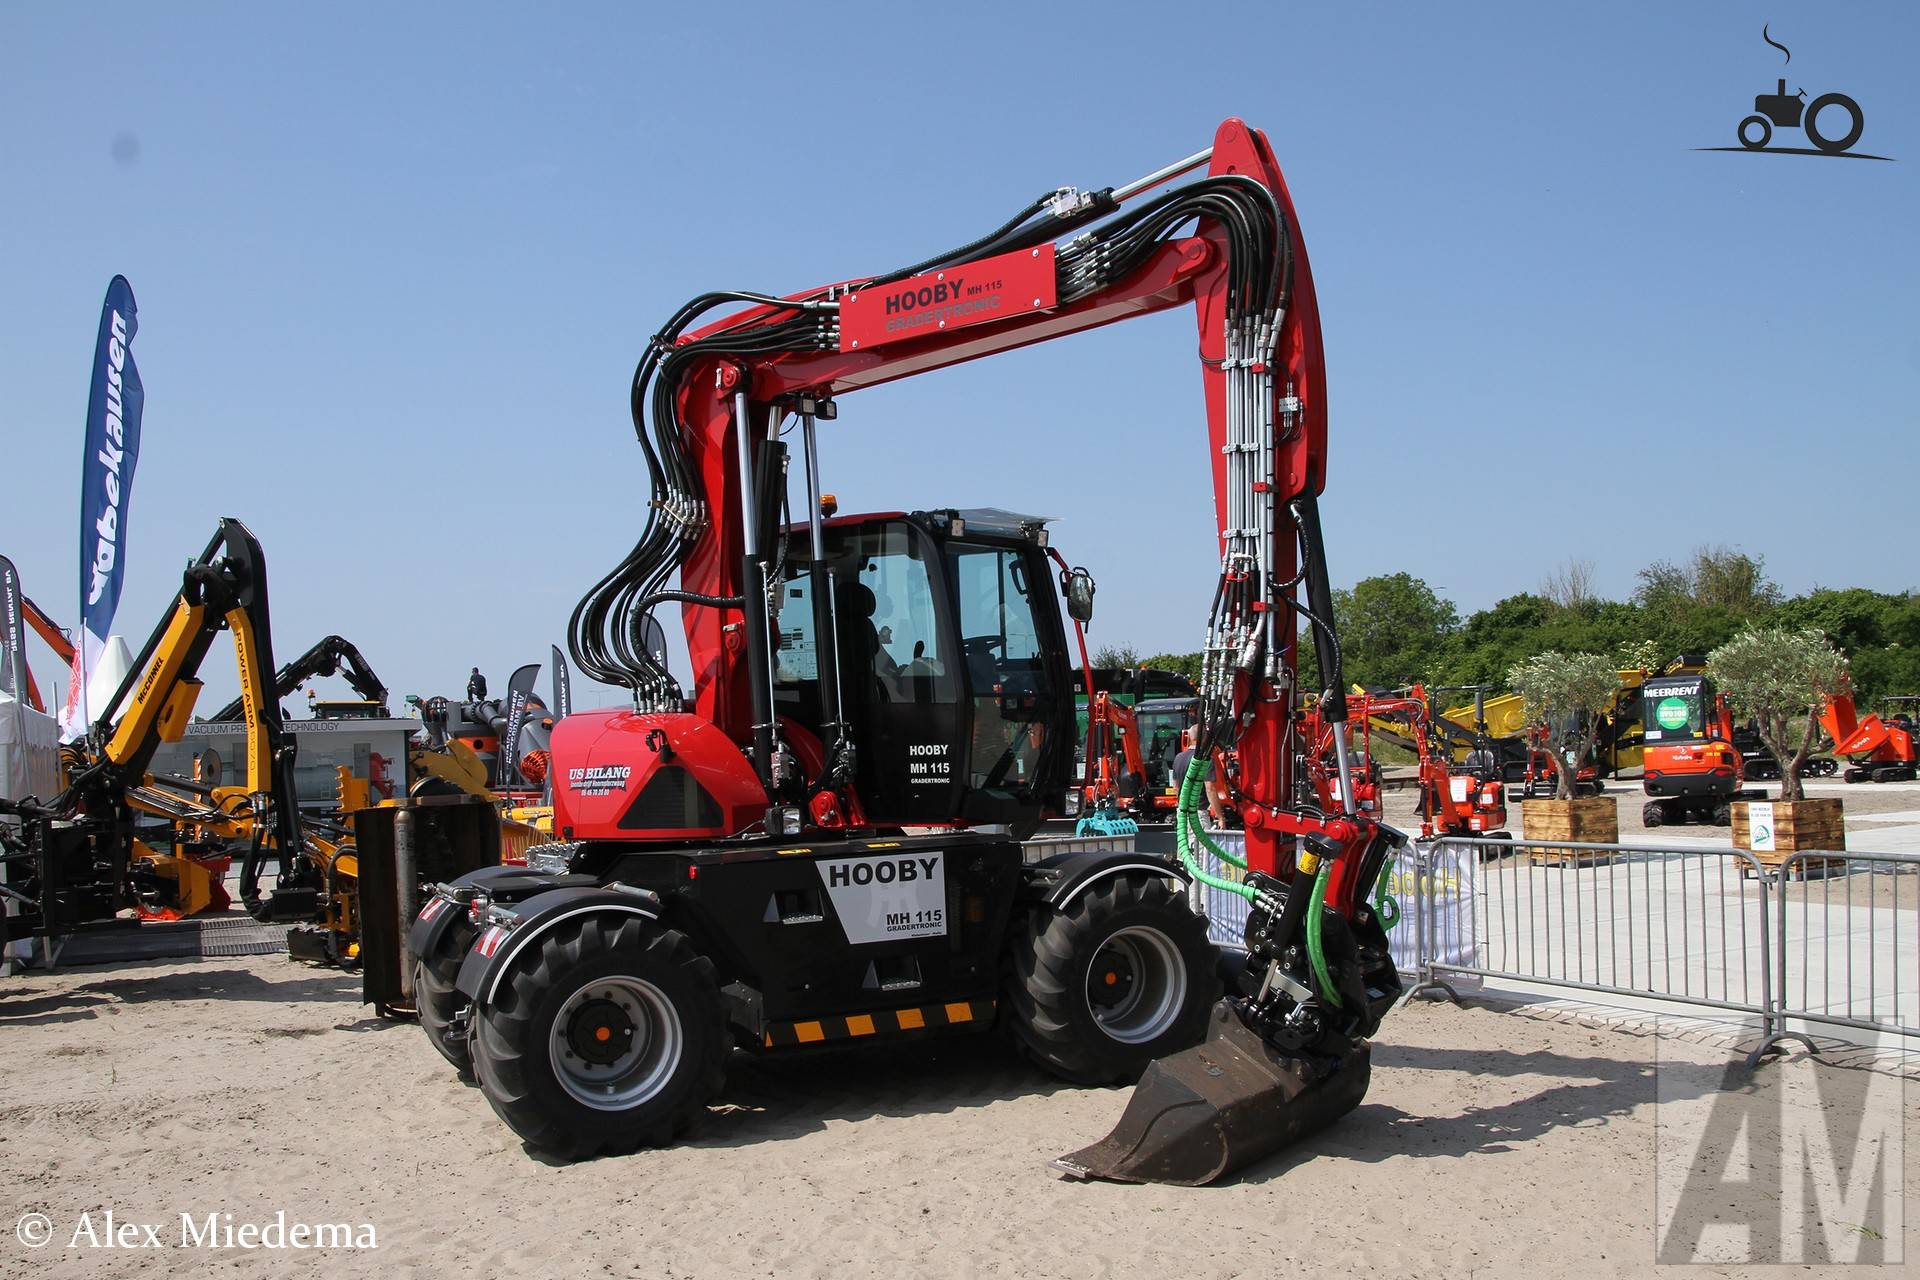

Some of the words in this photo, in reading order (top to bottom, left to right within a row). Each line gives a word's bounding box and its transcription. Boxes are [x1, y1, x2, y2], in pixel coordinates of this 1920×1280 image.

[886, 279, 964, 315] HOOBY
[967, 285, 982, 296] MH
[985, 280, 1002, 292] 115
[886, 295, 1001, 332] GRADERTRONIC
[236, 632, 249, 689] POWER
[245, 693, 254, 728] ARM
[1644, 686, 1699, 697] MEERRENT
[188, 725, 228, 734] VACUUM
[909, 744, 949, 756] HOOBY
[569, 768, 584, 780] US
[585, 766, 631, 779] BILANG
[910, 763, 927, 774] MH
[930, 762, 950, 774] 115
[829, 857, 938, 888] HOOBY
[886, 912, 910, 926] MH
[915, 909, 942, 923] 115
[886, 921, 942, 932] GRADERTRONIC
